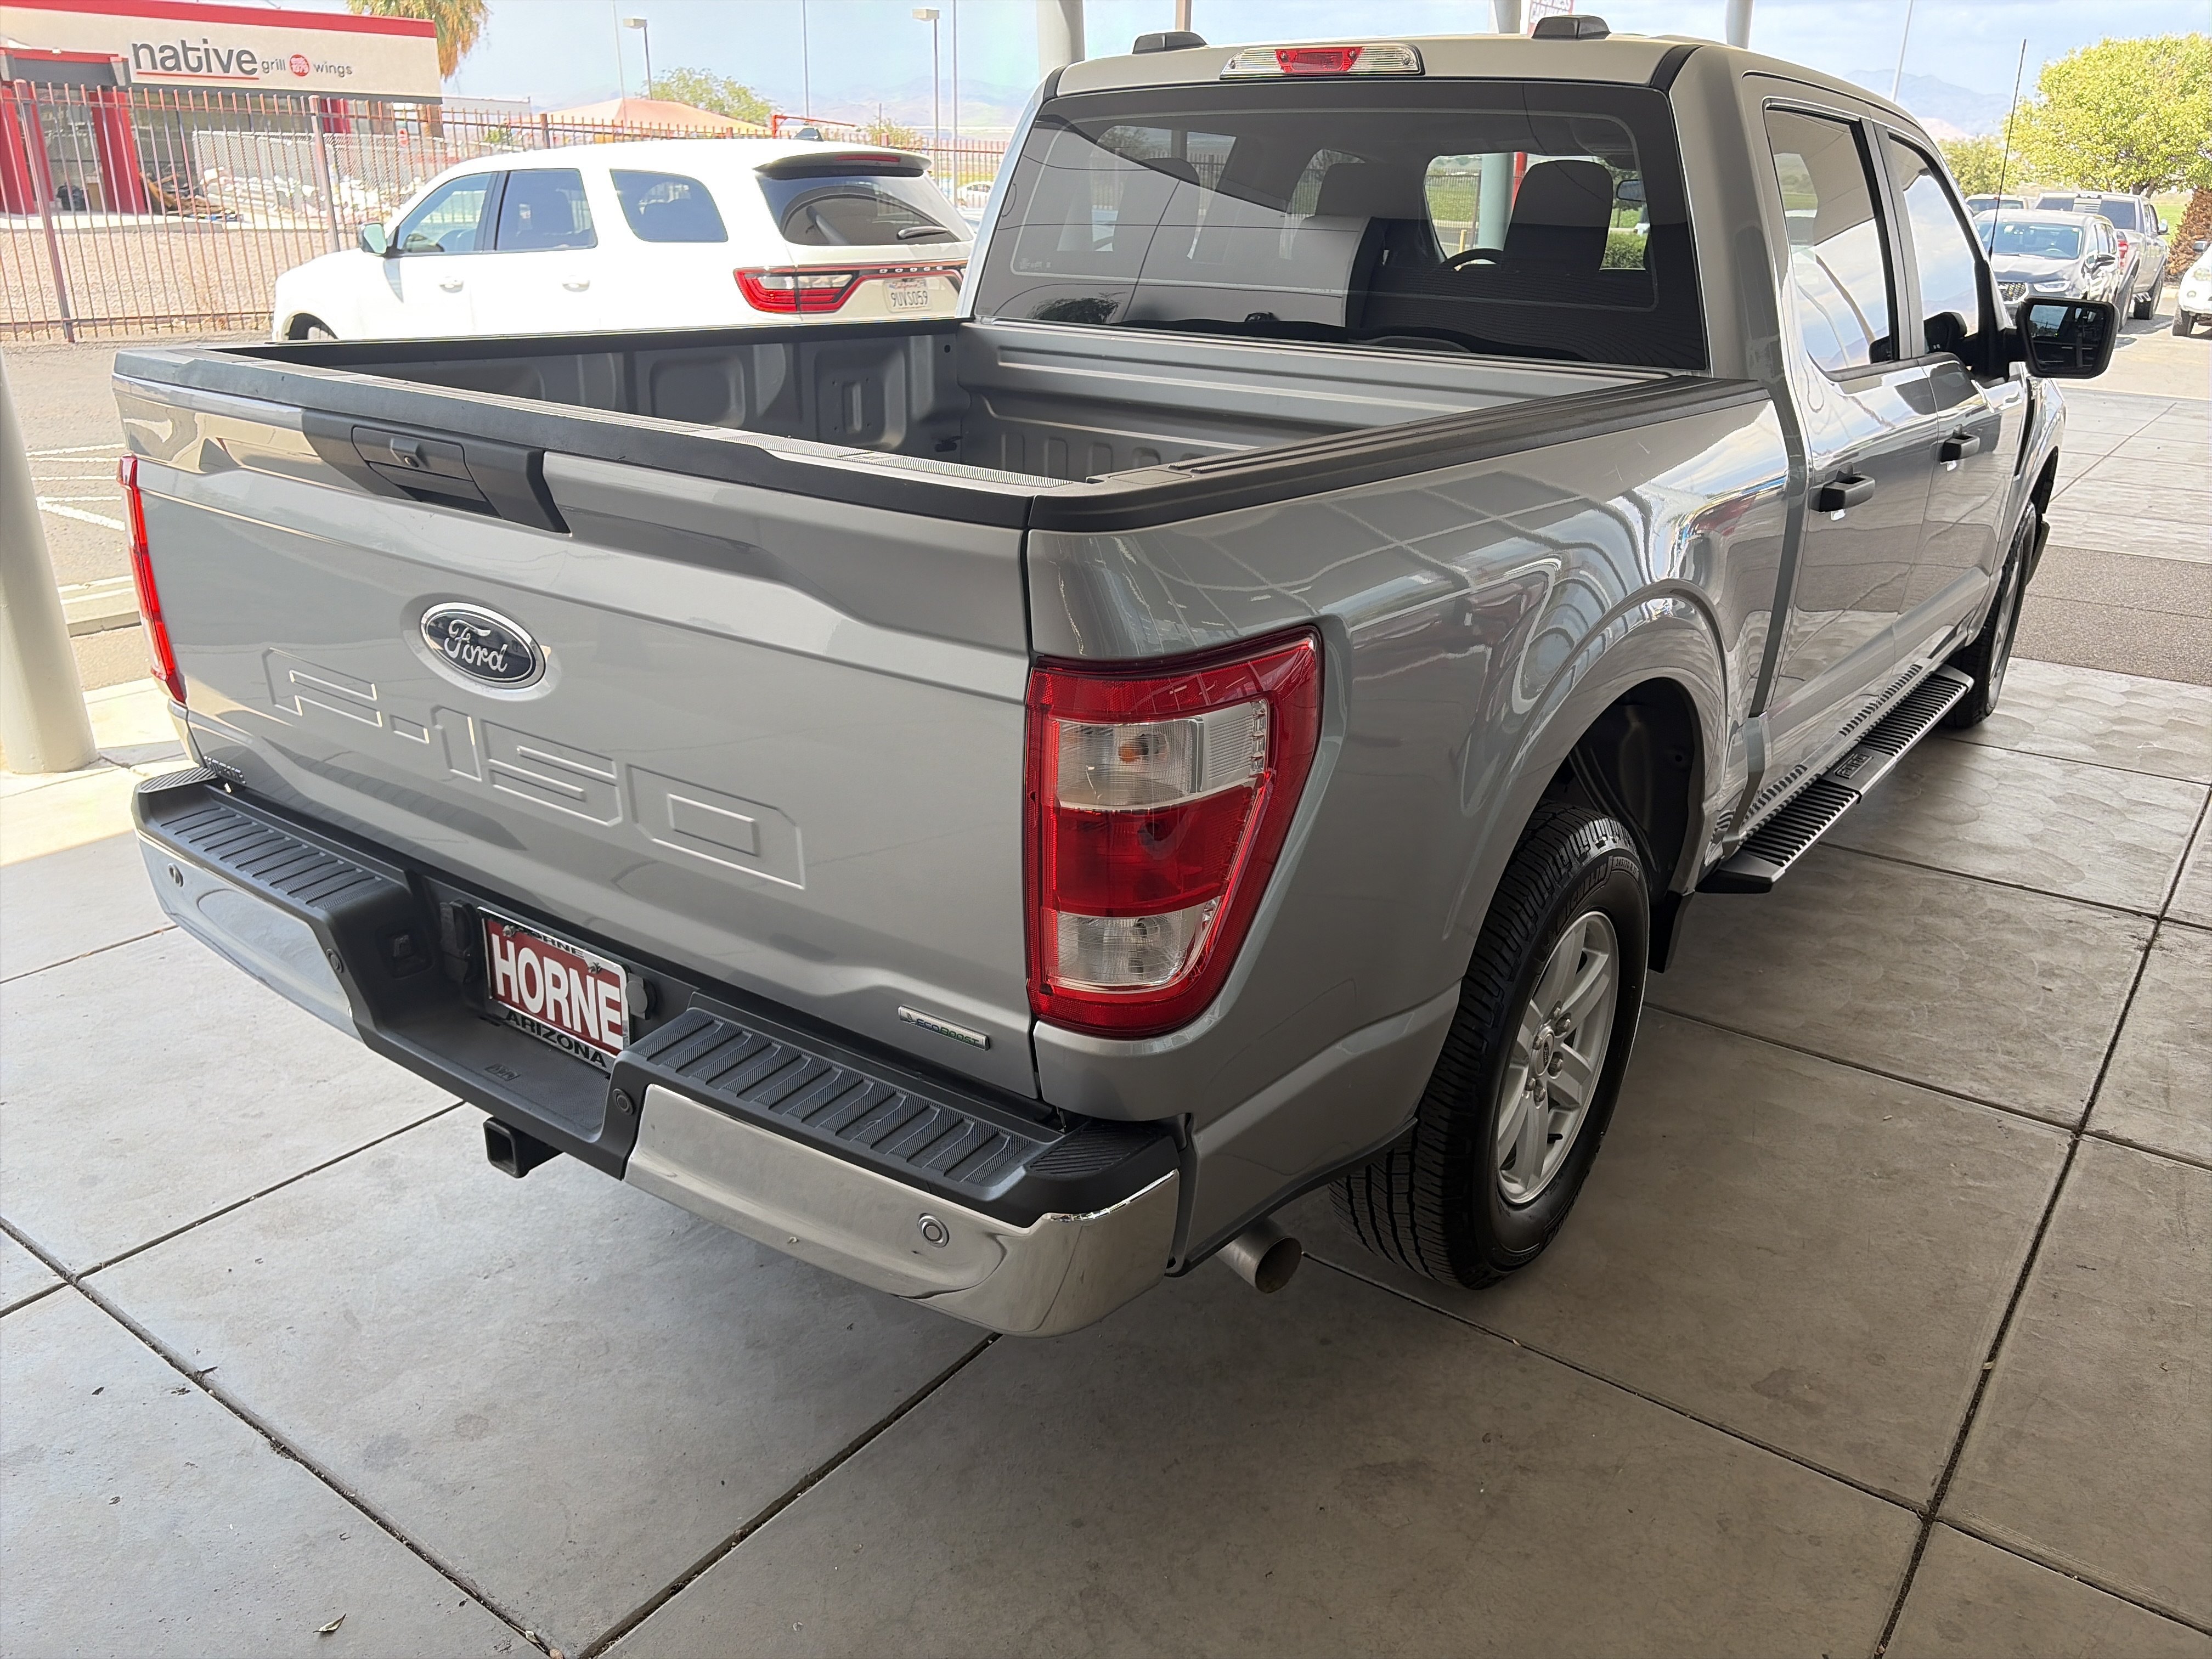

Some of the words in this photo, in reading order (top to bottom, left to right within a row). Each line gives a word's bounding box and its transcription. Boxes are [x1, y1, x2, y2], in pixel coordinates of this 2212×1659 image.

[132, 38, 257, 75] native
[261, 58, 286, 74] grill
[313, 61, 353, 78] wings
[443, 619, 508, 673] Ford
[262, 647, 806, 889] F-150
[492, 933, 623, 1050] HORNE
[505, 1011, 607, 1068] ARIZONA
